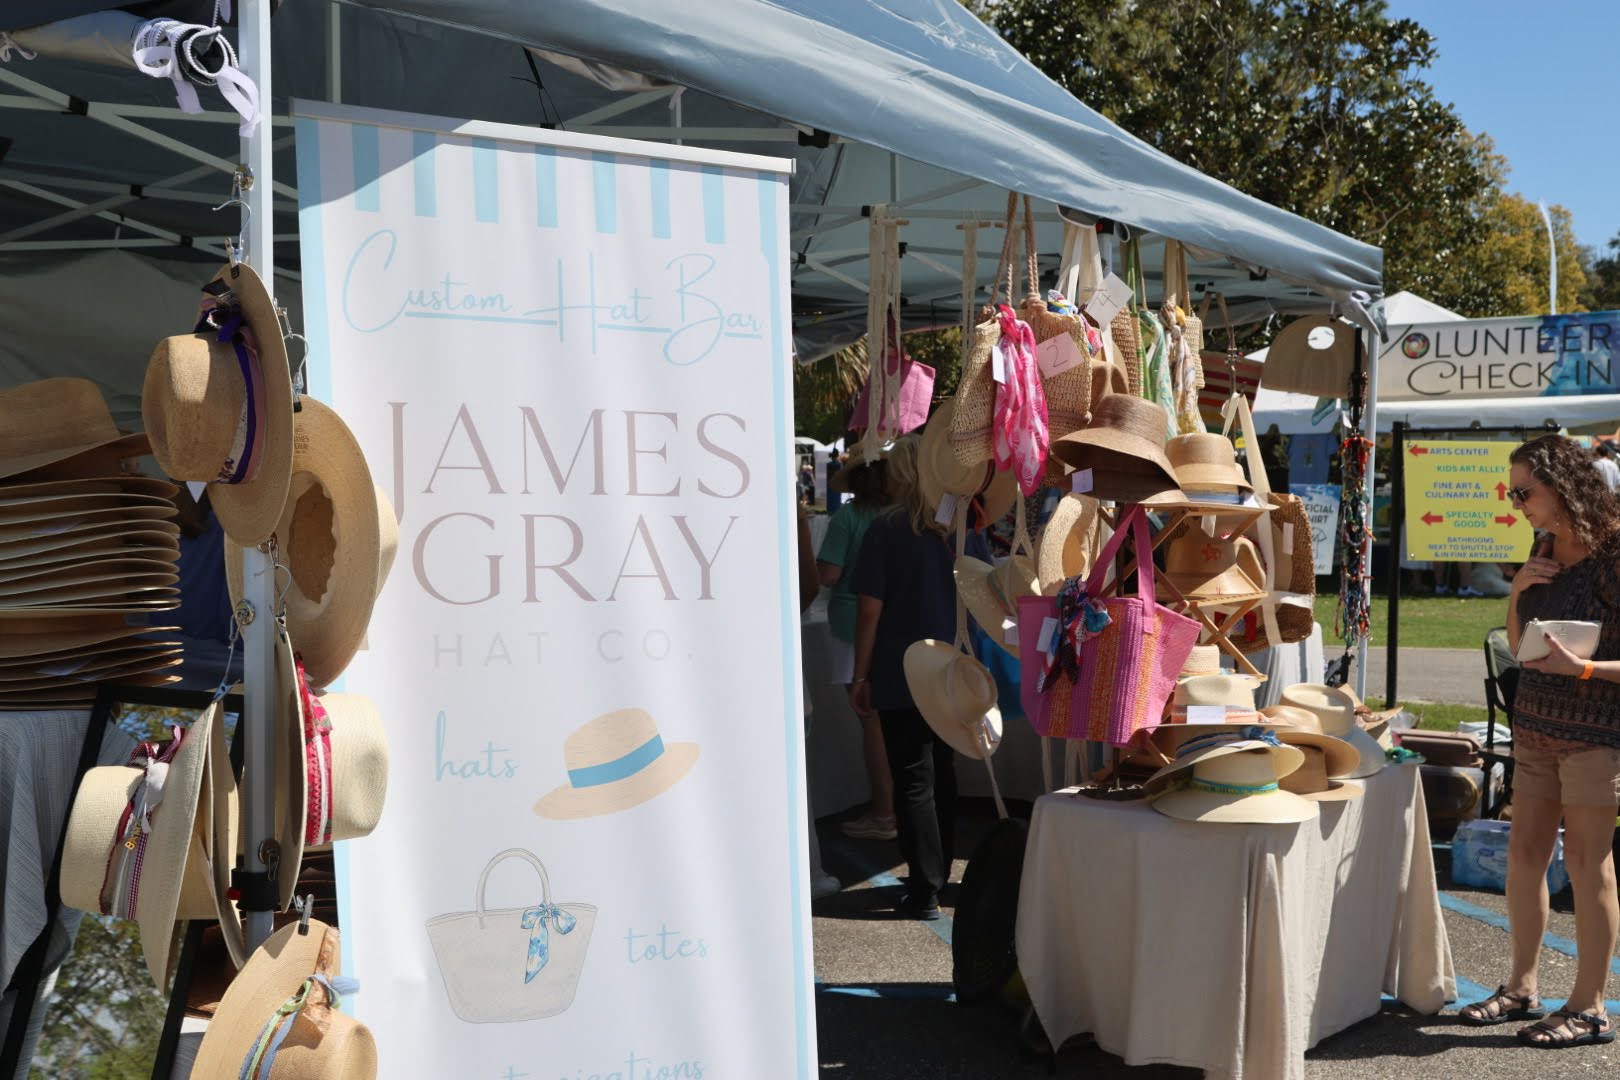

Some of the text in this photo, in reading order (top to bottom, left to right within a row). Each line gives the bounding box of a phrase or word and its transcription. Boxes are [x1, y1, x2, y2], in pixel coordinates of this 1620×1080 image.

[343, 230, 767, 365] Custom Hat Bar
[1407, 358, 1611, 396] CHECK-IN
[387, 401, 751, 526] JAMES
[1430, 448, 1489, 456] ARTS CENTER
[1436, 465, 1506, 473] KIDS ART ALLEY
[1425, 491, 1489, 499] CULINARY ART
[1446, 511, 1494, 519] SPECIALTY
[1454, 520, 1487, 528] GOODS
[412, 511, 741, 606] GRAY
[433, 629, 693, 669] HAT CO.
[436, 710, 520, 783] hats
[624, 921, 712, 965] totes
